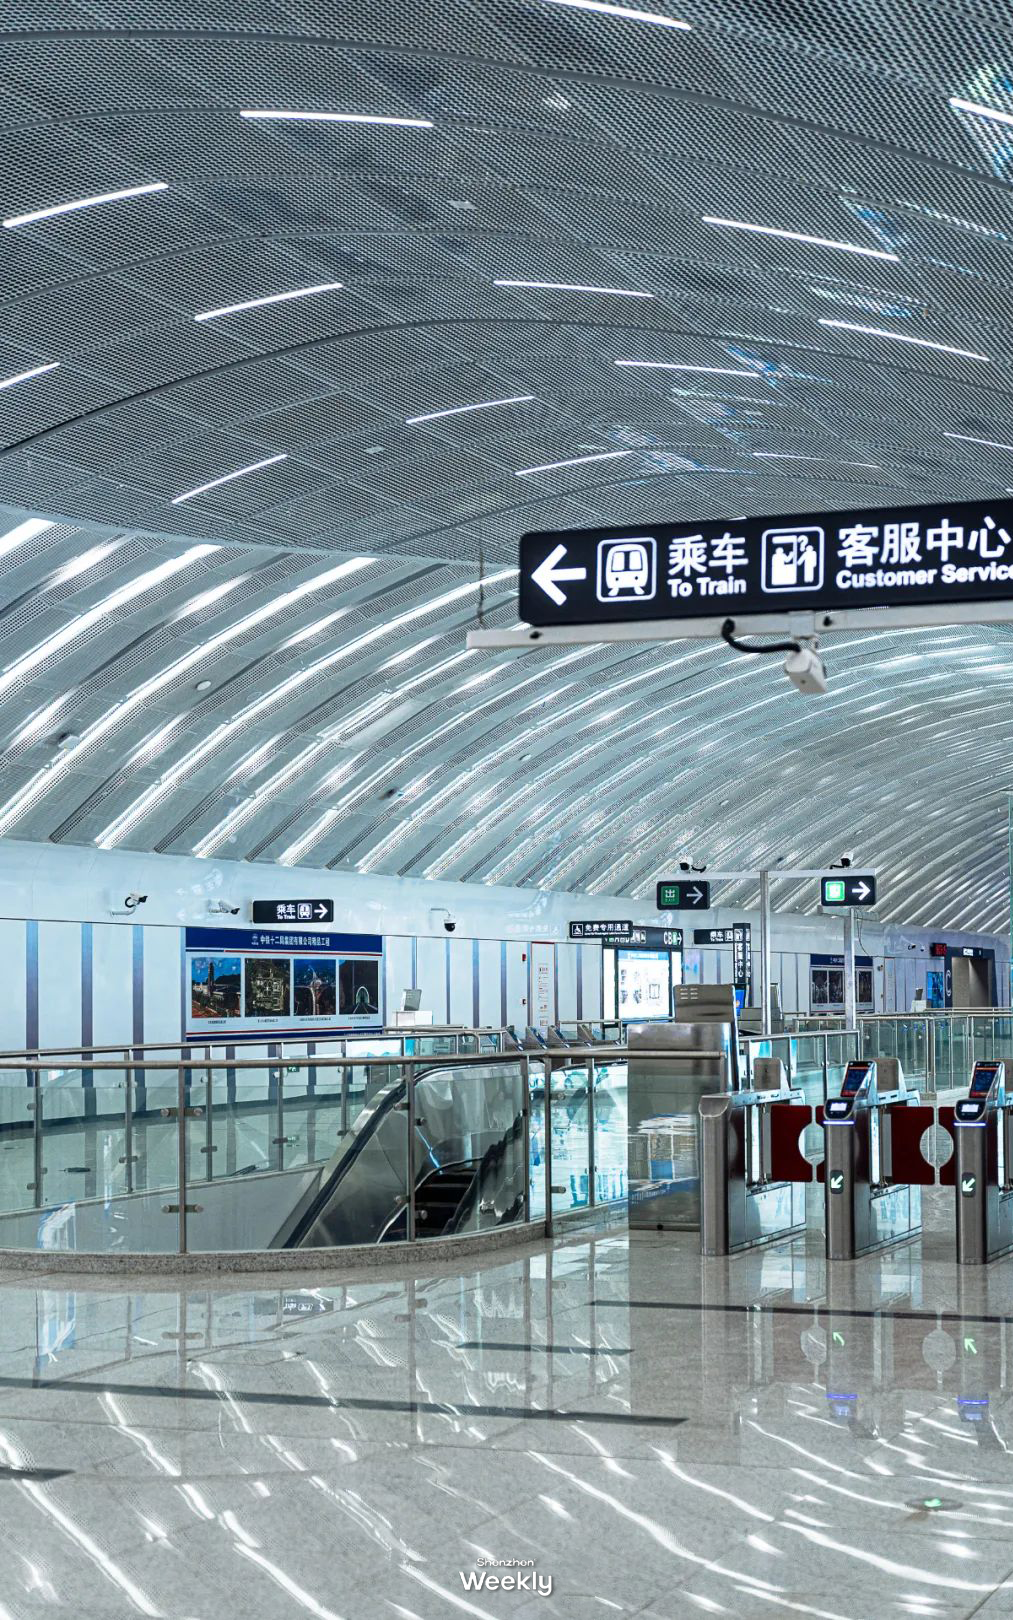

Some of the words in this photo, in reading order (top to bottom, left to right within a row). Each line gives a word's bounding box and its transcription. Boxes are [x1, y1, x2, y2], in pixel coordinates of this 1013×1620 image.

[837, 516, 1012, 568] 客服中心
[667, 532, 749, 577] 乘车
[667, 578, 693, 598] To
[695, 575, 747, 596] Train
[835, 568, 938, 589] Customer
[277, 904, 296, 915] 乘车
